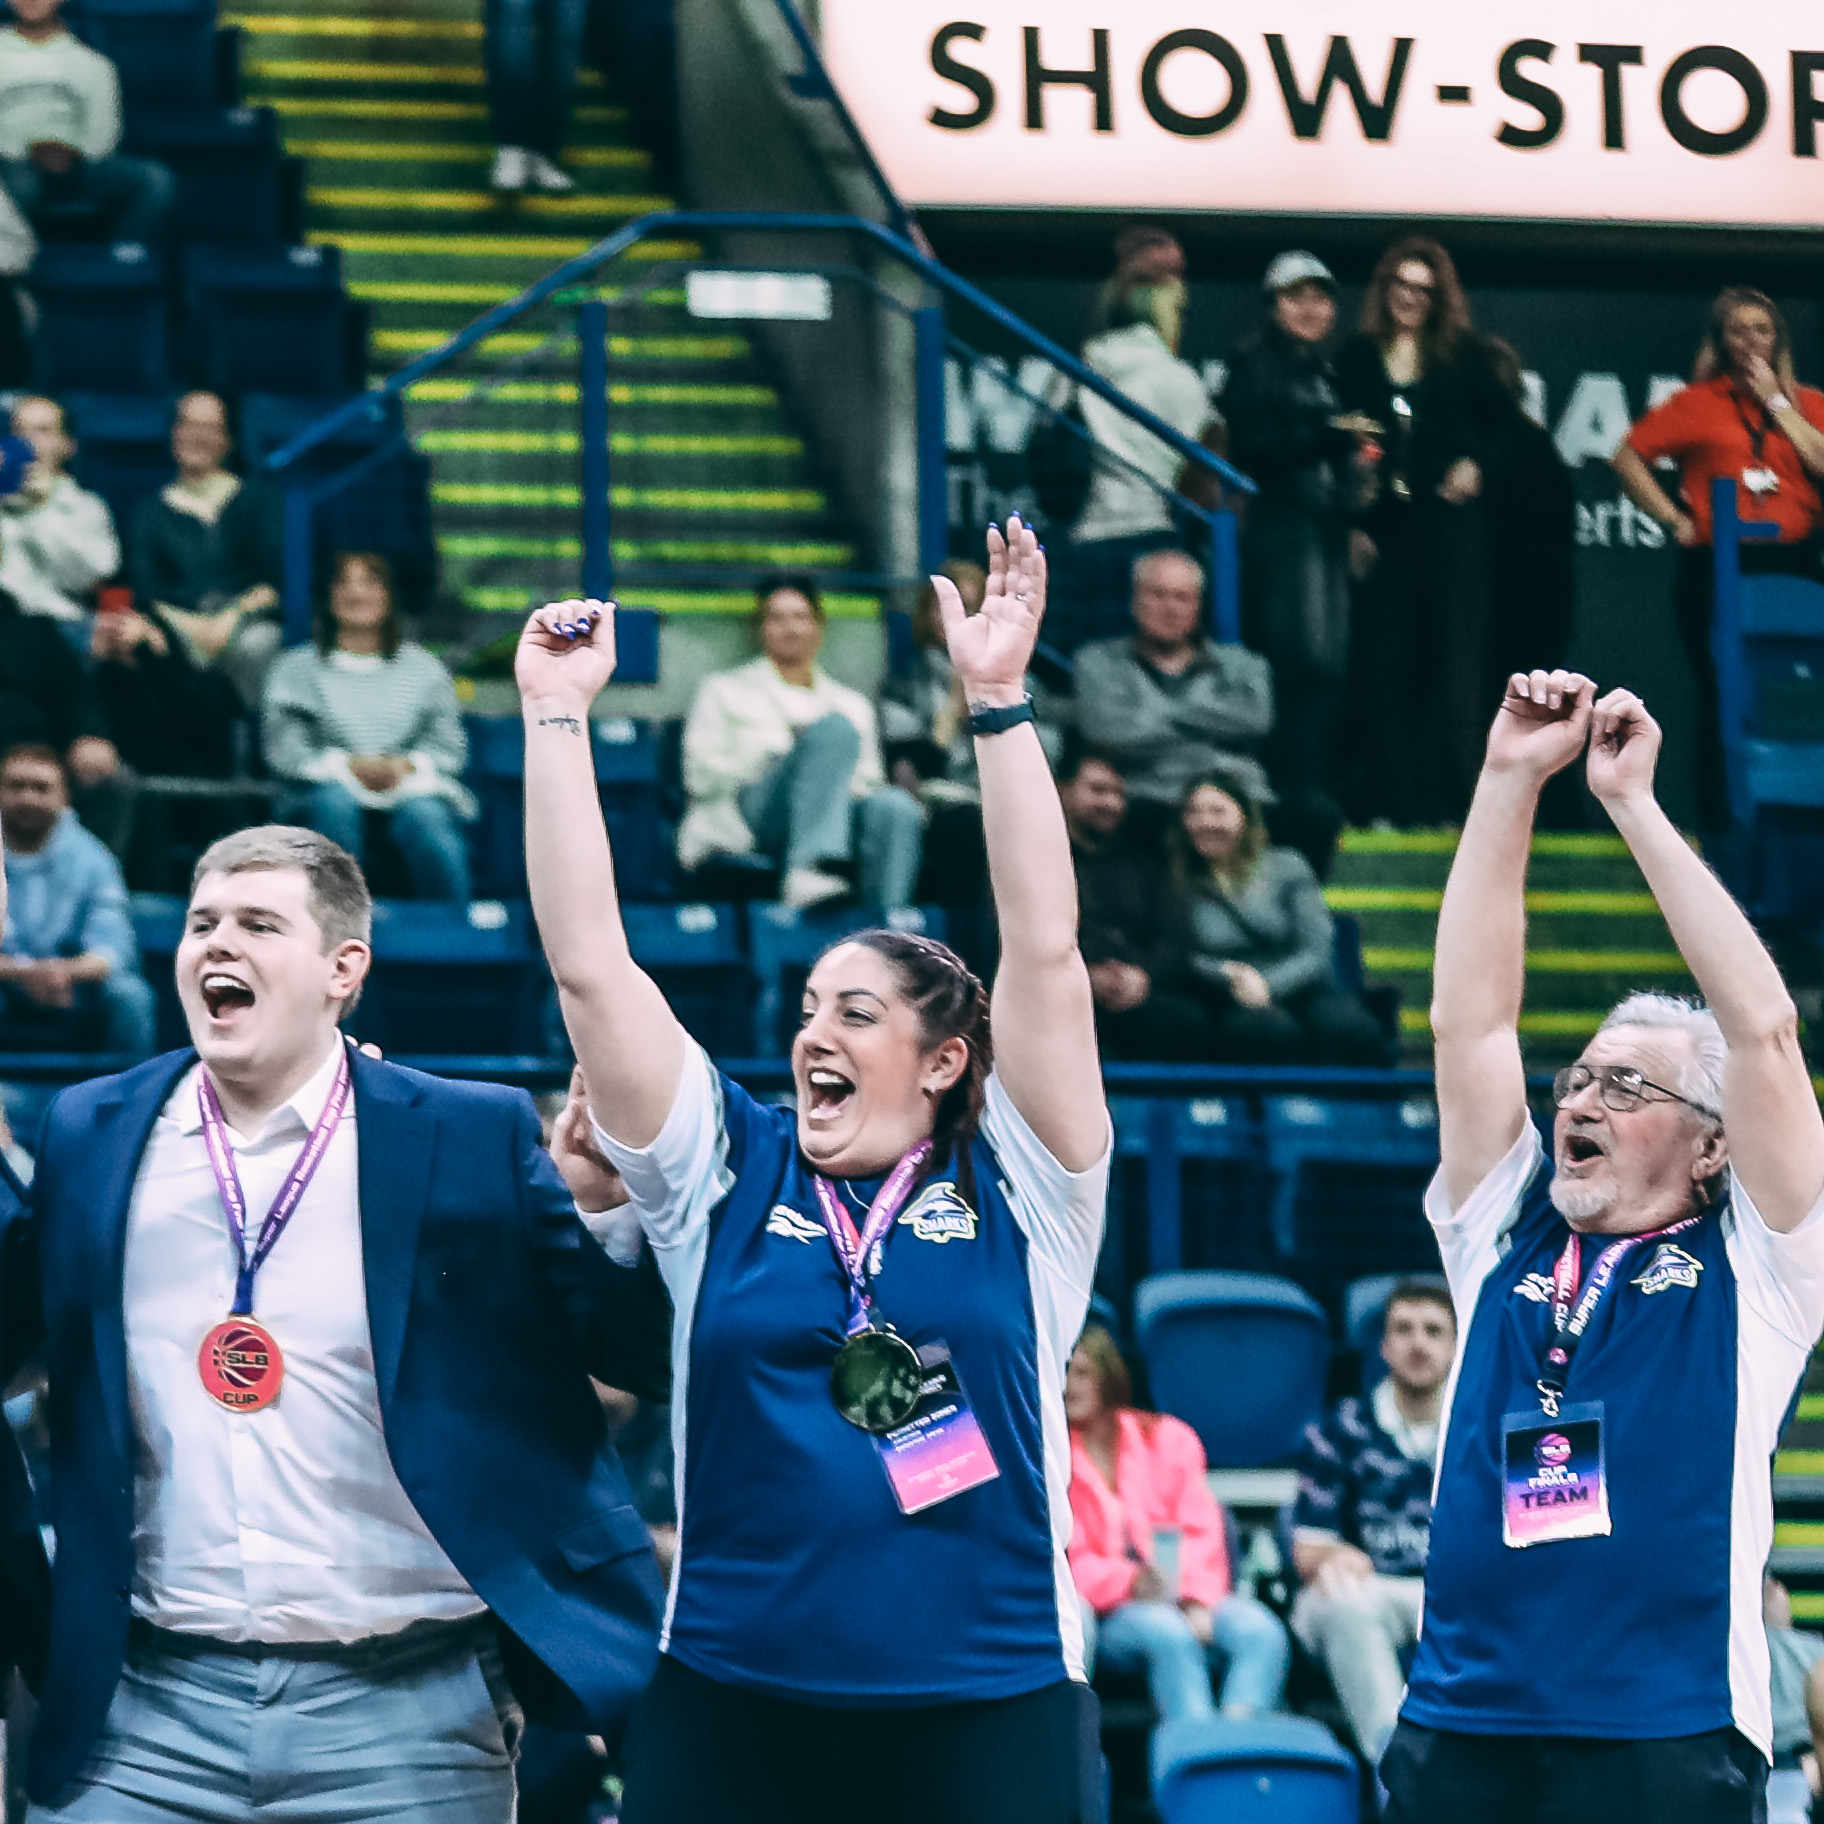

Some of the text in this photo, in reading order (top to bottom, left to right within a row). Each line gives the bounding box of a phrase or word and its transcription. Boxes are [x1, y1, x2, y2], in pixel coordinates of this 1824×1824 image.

[918, 1215, 971, 1235] SHARKS
[1568, 1283, 1603, 1337] SUPER
[226, 1349, 270, 1366] SLB
[222, 1392, 260, 1405] CUP
[1518, 1485, 1589, 1510] TEAM
